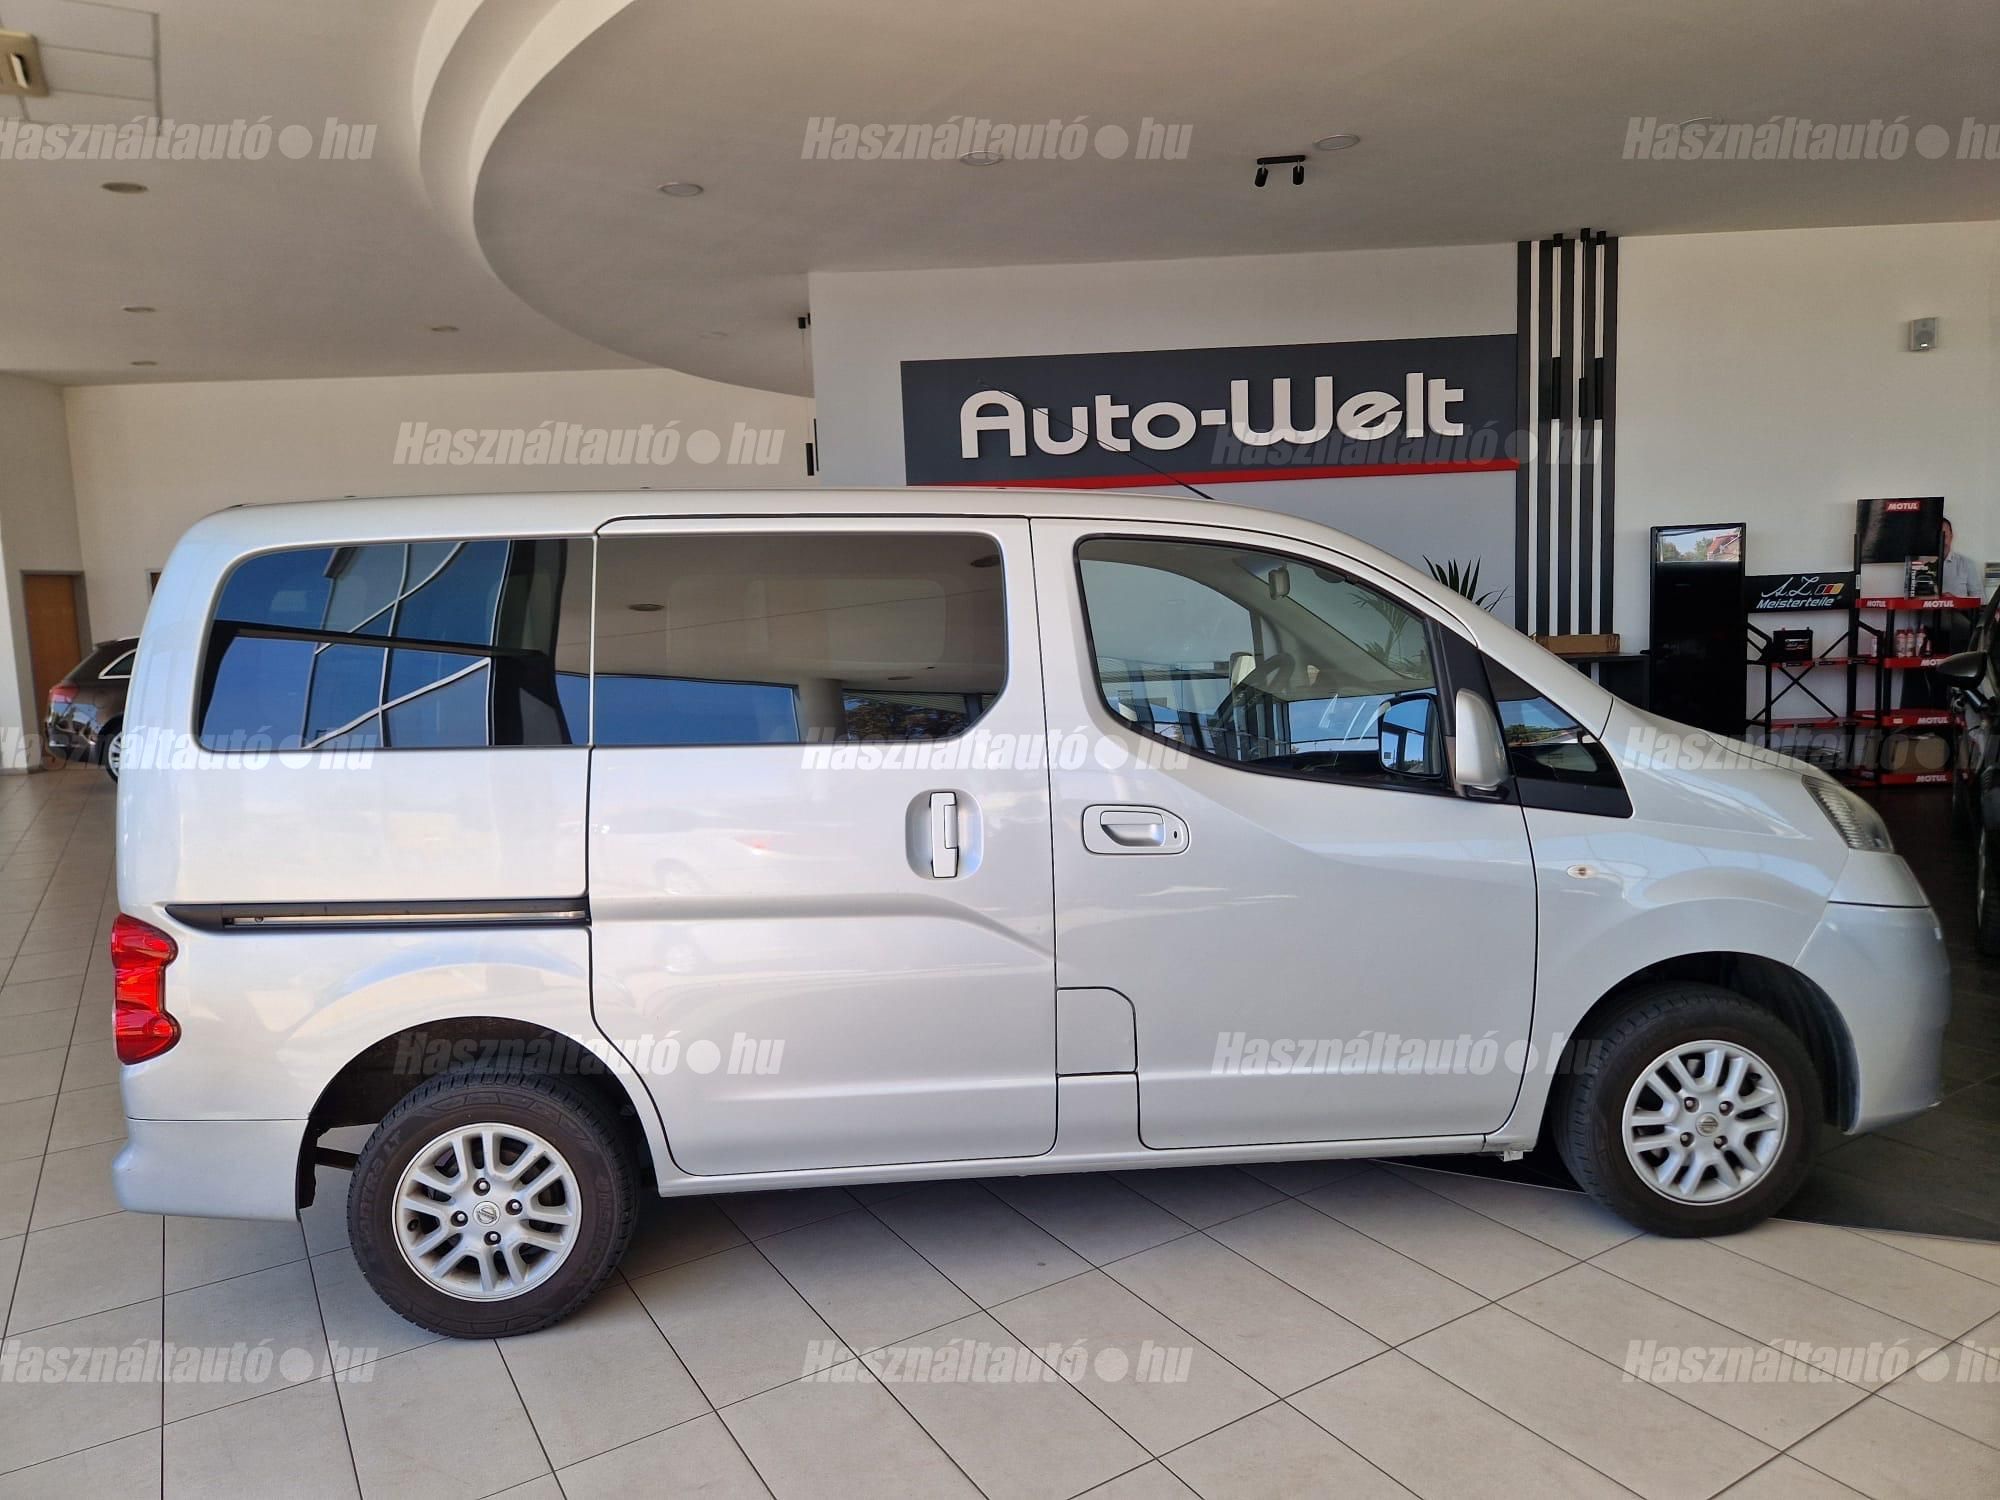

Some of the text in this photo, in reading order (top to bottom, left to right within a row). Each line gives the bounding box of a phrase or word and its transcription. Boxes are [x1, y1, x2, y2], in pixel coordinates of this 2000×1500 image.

[960, 372, 1465, 459] Auto-Welt
[1887, 502, 1918, 511] MOTUL
[1756, 597, 1835, 609] Meisterteile
[1866, 600, 1887, 608] MOTUL
[1923, 600, 1954, 608] MOTUL
[1917, 716, 1949, 725] MOTUL
[1916, 774, 1948, 783] MOTUL
